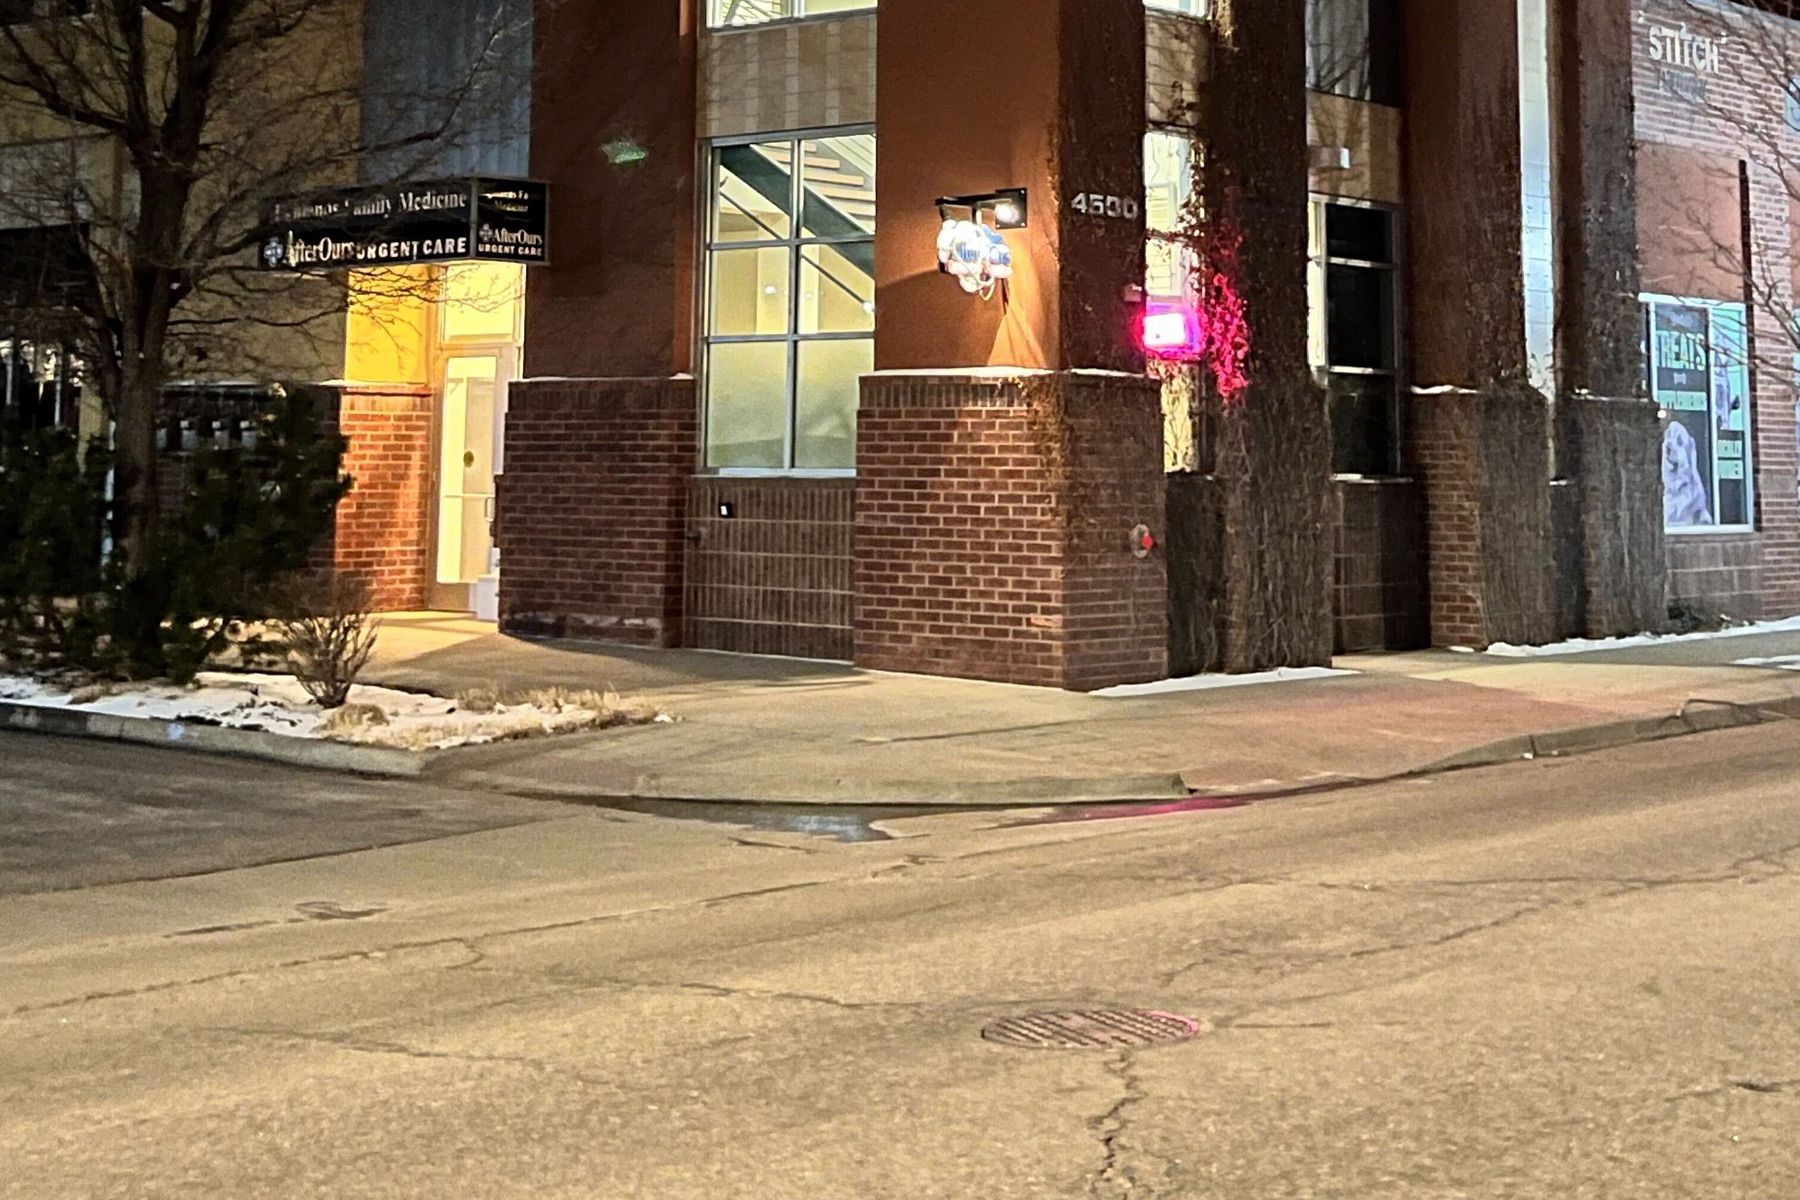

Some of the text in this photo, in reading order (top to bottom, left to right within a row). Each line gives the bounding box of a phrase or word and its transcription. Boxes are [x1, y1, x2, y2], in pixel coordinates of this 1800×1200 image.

[1649, 24, 1719, 74] STITCH
[399, 190, 467, 212] Medicine
[1071, 191, 1138, 220] 4500
[423, 237, 467, 255] CARE
[493, 227, 543, 246] AfterOurs
[478, 243, 543, 257] URGENT CARE
[1656, 330, 1706, 371] TREATS
